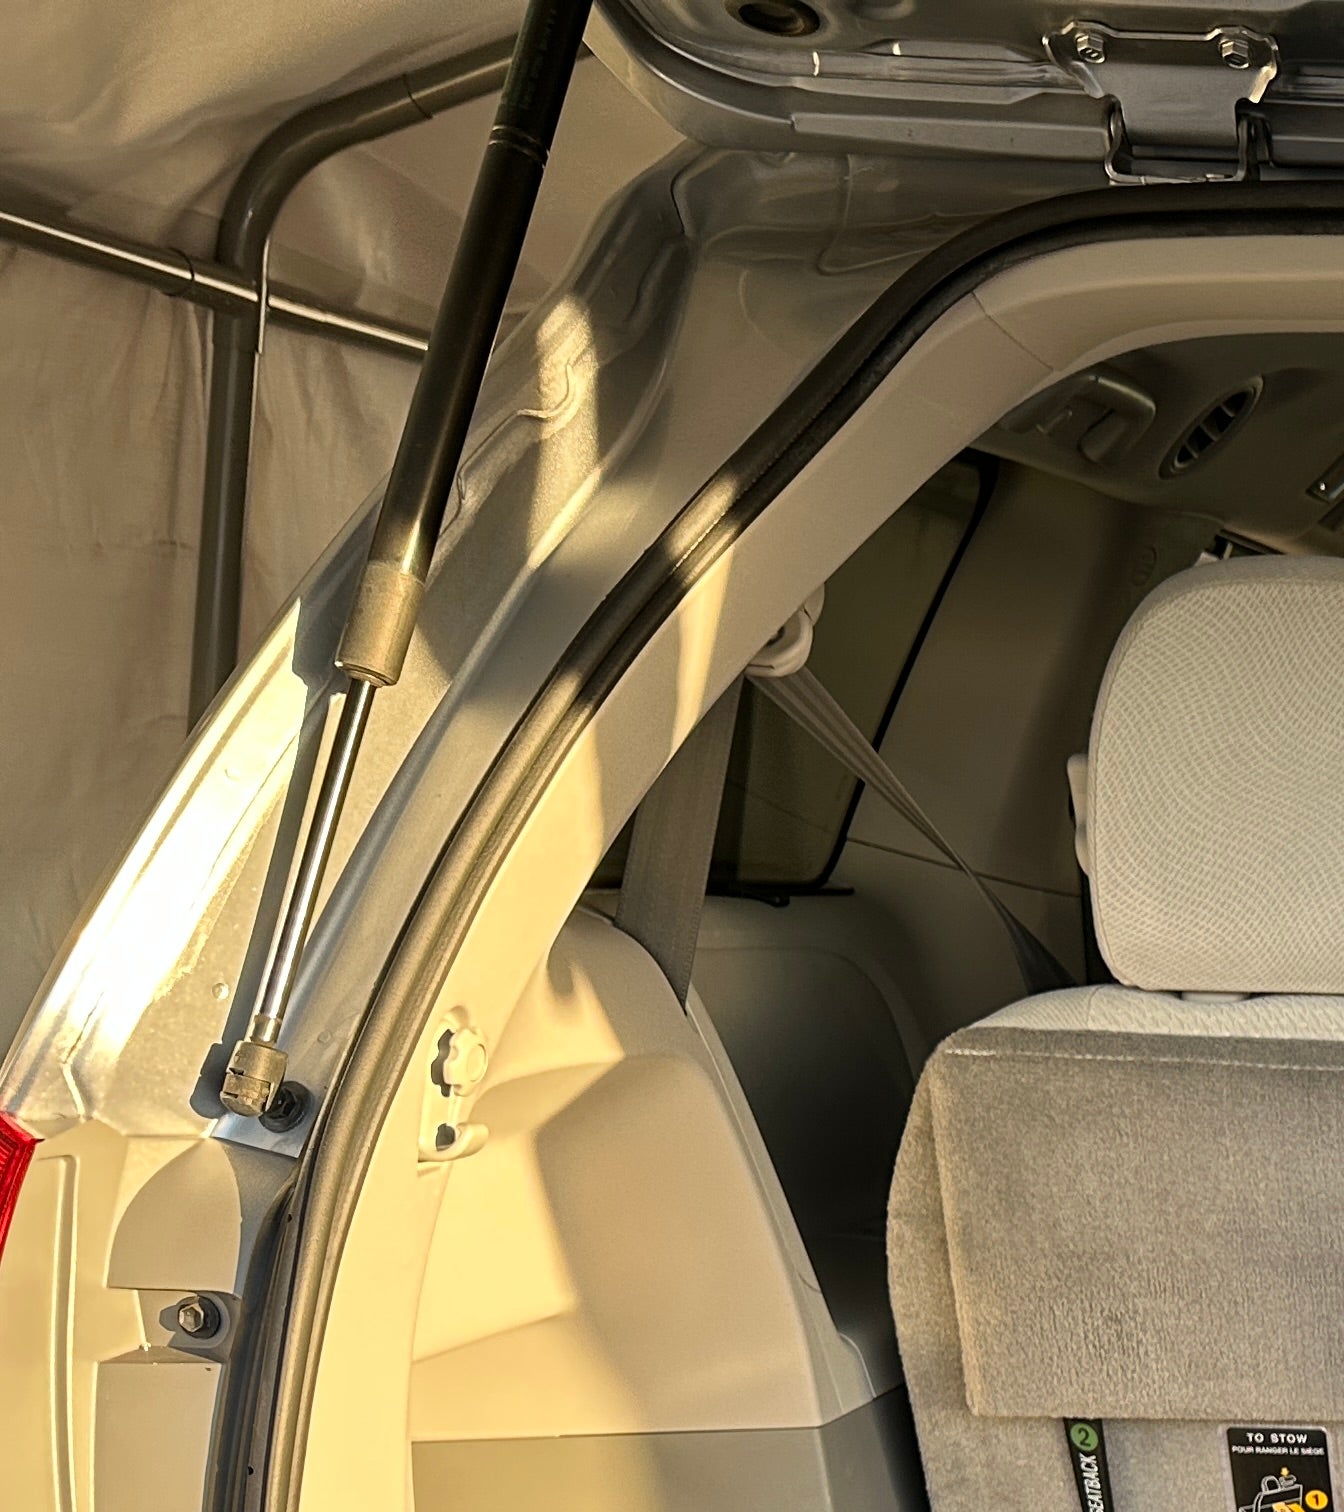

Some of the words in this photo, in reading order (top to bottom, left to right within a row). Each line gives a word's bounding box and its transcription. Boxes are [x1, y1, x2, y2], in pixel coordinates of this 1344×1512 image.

[1078, 1428, 1092, 1447] 2
[1246, 1432, 1264, 1443] TO
[1270, 1433, 1308, 1444] STOW
[1312, 1494, 1319, 1506] 1
